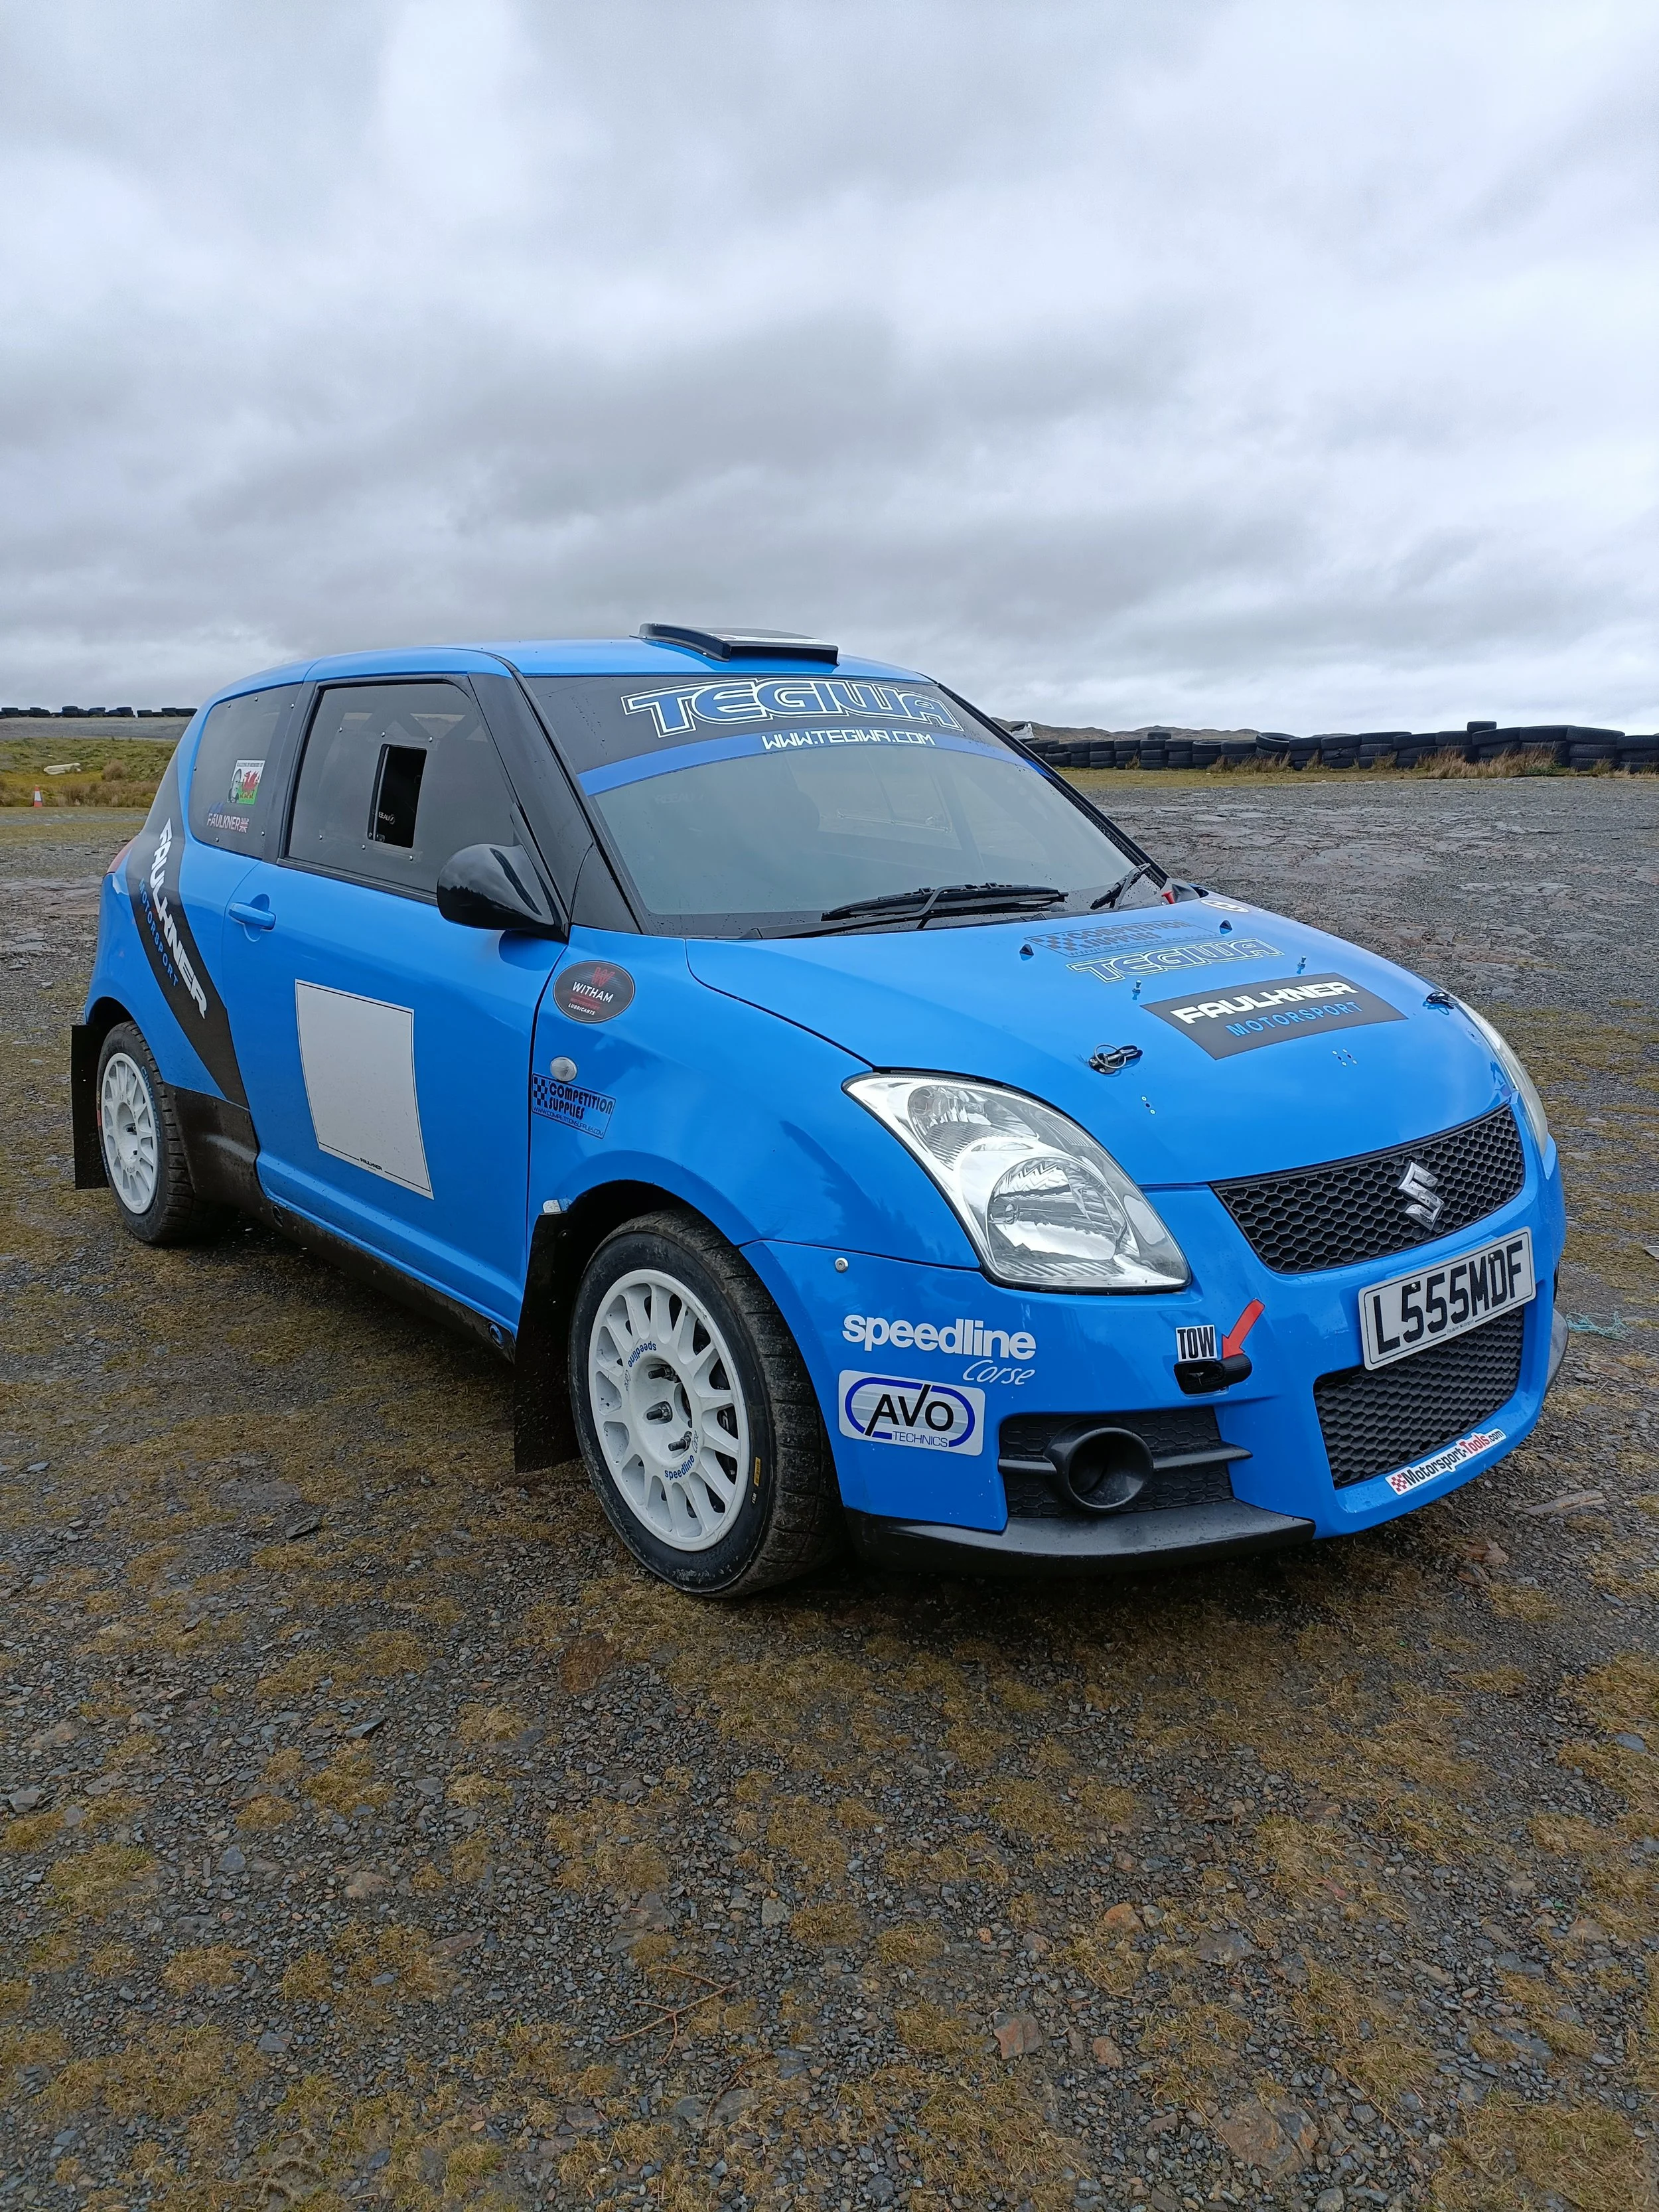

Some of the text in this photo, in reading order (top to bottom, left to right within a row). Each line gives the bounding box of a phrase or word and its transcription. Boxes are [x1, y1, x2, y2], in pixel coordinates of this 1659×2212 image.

[620, 677, 964, 738] TEGIWA
[762, 729, 936, 750] WWW.TEGIWA.COM
[207, 813, 240, 832] FAULKNER
[139, 877, 179, 987] MOTORSPORT
[149, 818, 207, 1019] FAULKNER
[1066, 920, 1193, 941] COMPETITION
[1083, 931, 1162, 948] SUPPLIES
[1066, 938, 1285, 983] TEGIWA
[568, 1003, 596, 1015] LUBRICANTS
[572, 982, 614, 1003] WITHAM
[1169, 981, 1359, 1025] FAULKNER
[1225, 1001, 1363, 1037] MOTORSPORT
[548, 1096, 585, 1120] SUPPLIES
[549, 1082, 613, 1115] COMPETITION
[1373, 1240, 1524, 1355] L555MDF
[842, 1314, 1036, 1360] speedline
[1177, 1326, 1214, 1360] TOW
[628, 1341, 657, 1368] speedline
[962, 1359, 1036, 1386] Corse
[864, 1384, 954, 1437] AVO
[892, 1431, 948, 1447] TECHNICS
[664, 1454, 695, 1481] speedline
[1401, 1430, 1504, 1486] Motorsport-Tools.com
